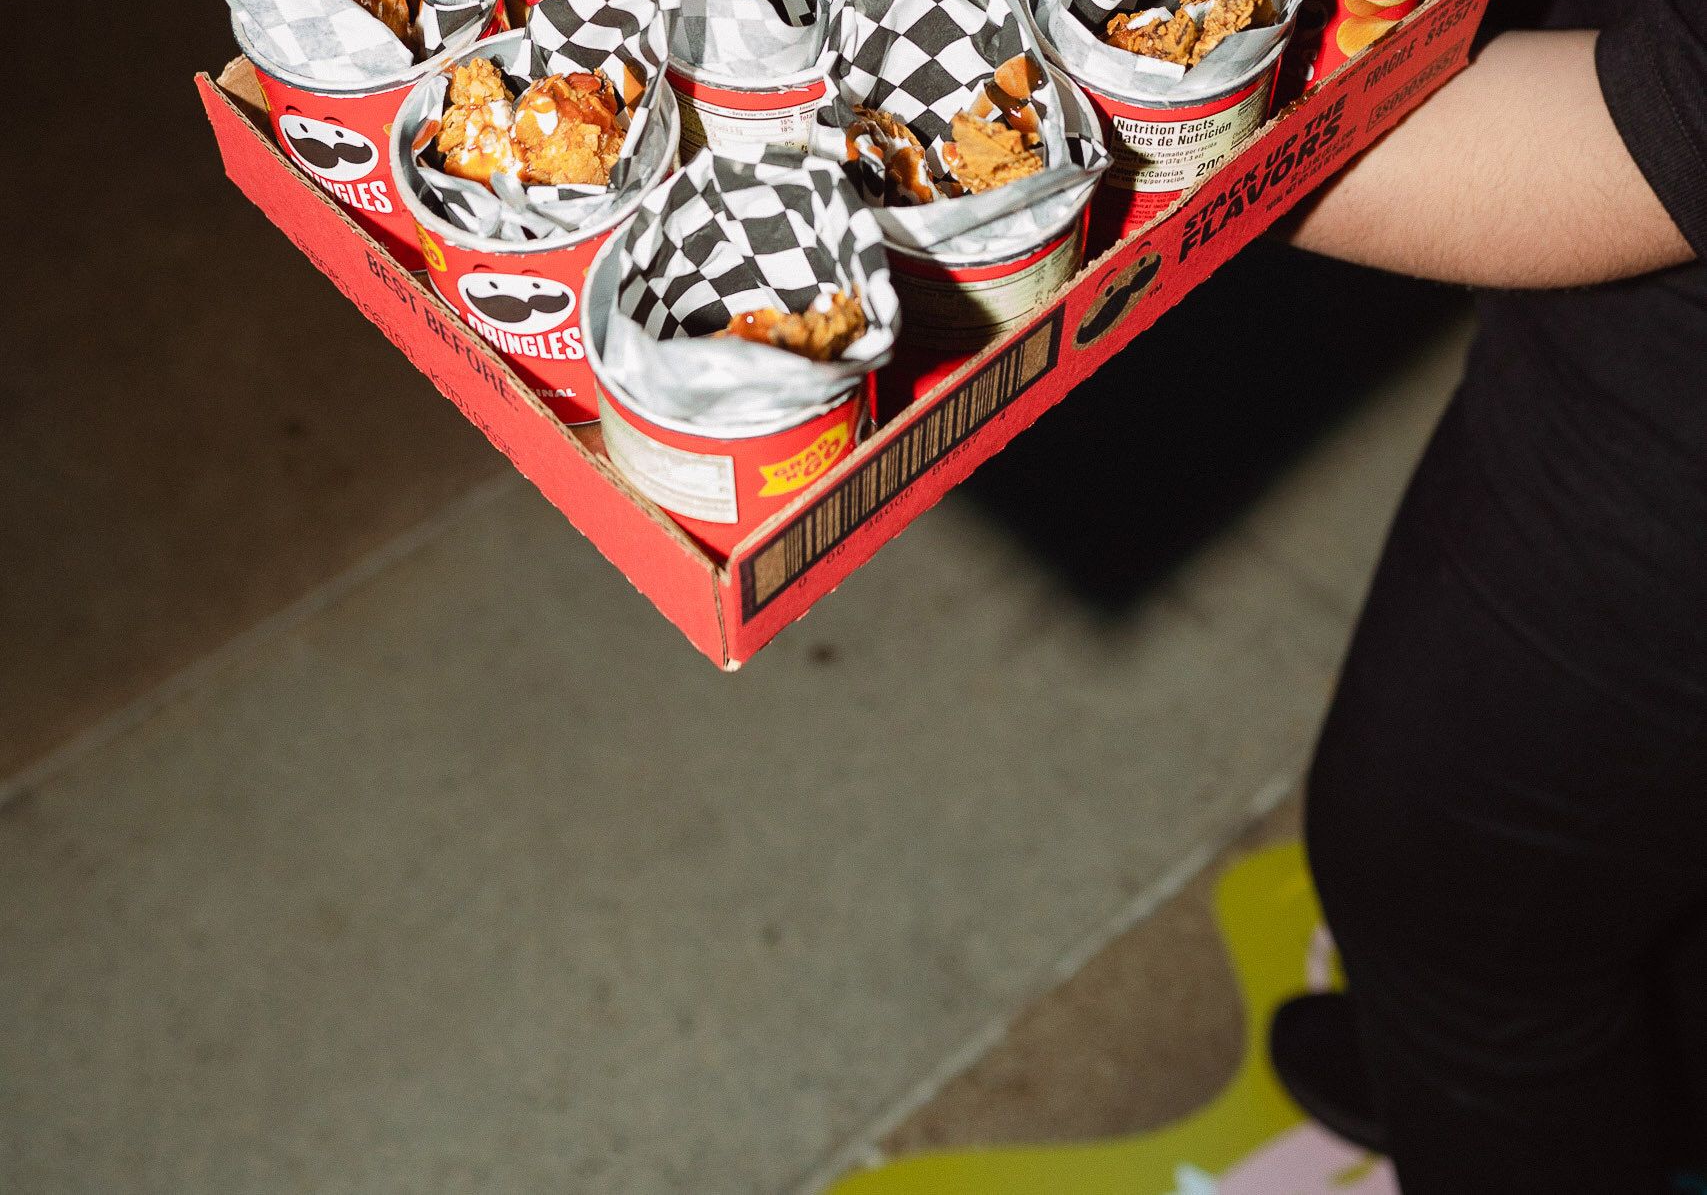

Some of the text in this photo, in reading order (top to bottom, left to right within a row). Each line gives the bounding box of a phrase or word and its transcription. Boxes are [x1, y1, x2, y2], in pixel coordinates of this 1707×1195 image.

[1364, 38, 1418, 93] FRAGILE
[1116, 118, 1214, 135] Nutrition Facts
[1157, 135, 1173, 146] de
[1177, 121, 1232, 146] Nutrición
[1183, 163, 1260, 233] STACK
[1265, 133, 1299, 168] UP
[1304, 93, 1348, 136] THE
[1179, 112, 1343, 264] FLAVORS
[365, 250, 519, 412] BEST BEFORE:
